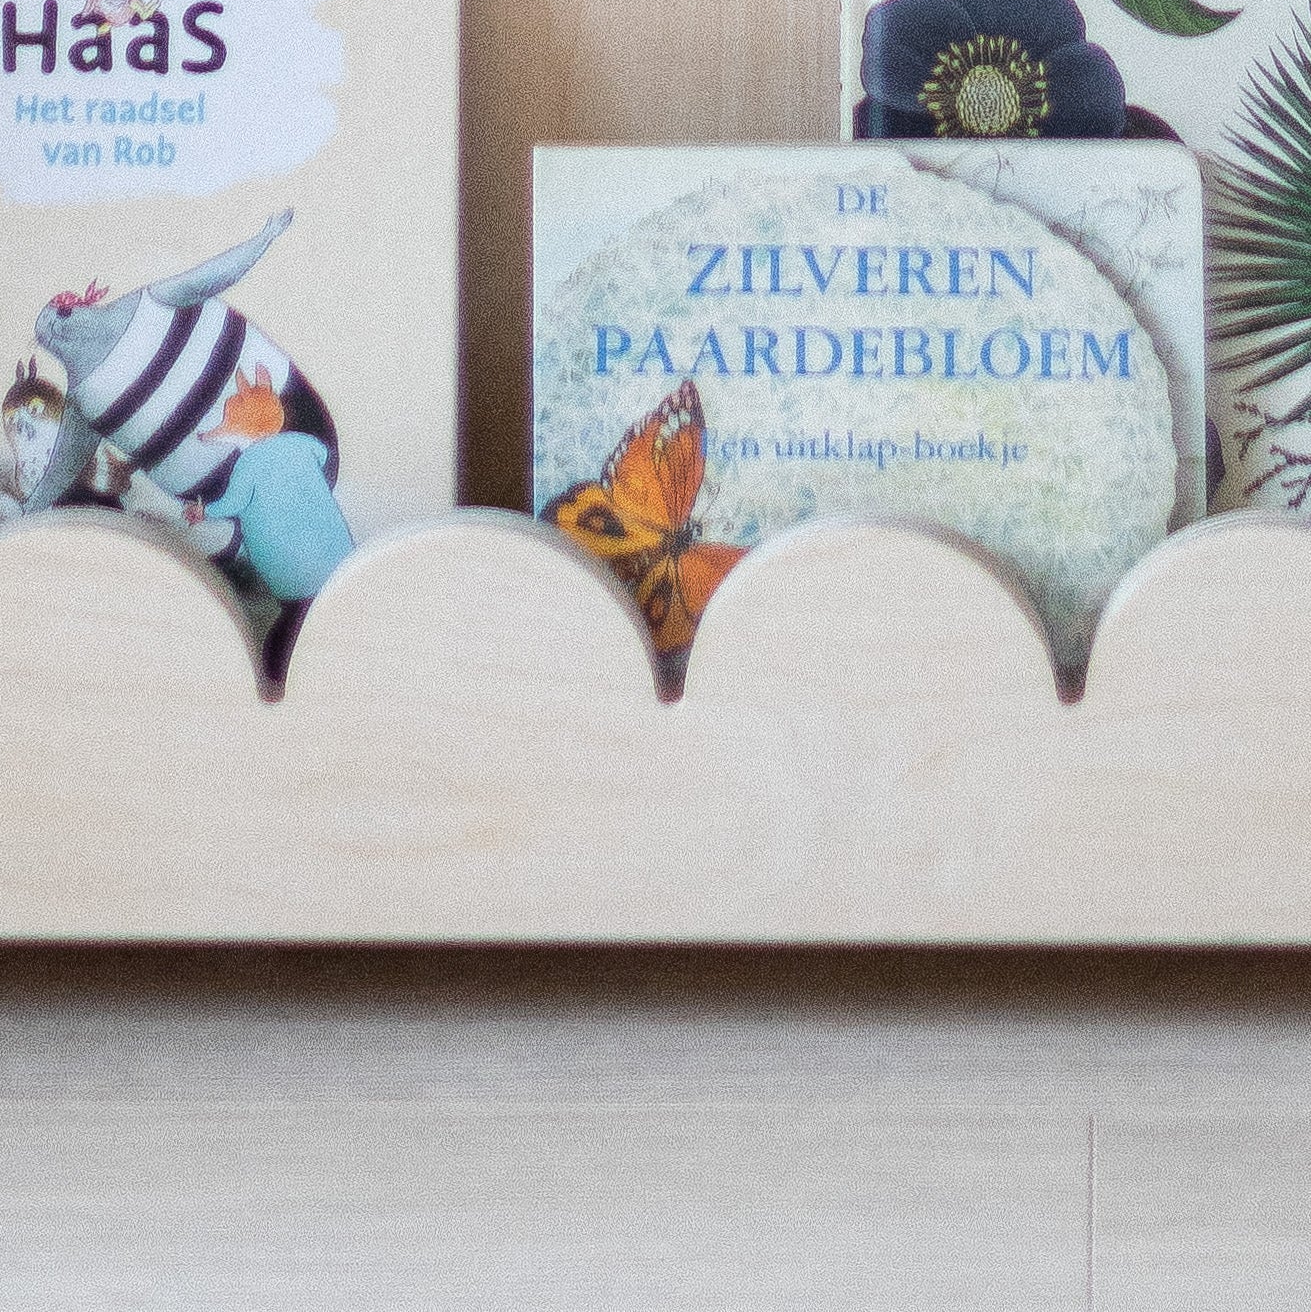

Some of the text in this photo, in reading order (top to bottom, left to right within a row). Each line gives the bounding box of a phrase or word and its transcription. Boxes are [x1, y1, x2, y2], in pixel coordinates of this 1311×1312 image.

[14, 93, 206, 125] Het raadsel
[43, 134, 177, 167] van Rob
[837, 184, 889, 217] DE
[688, 243, 1036, 299] ZILVEREN
[591, 324, 1136, 381] PAARDEBLOEM
[702, 427, 1030, 472] Een uitklap-boekje
